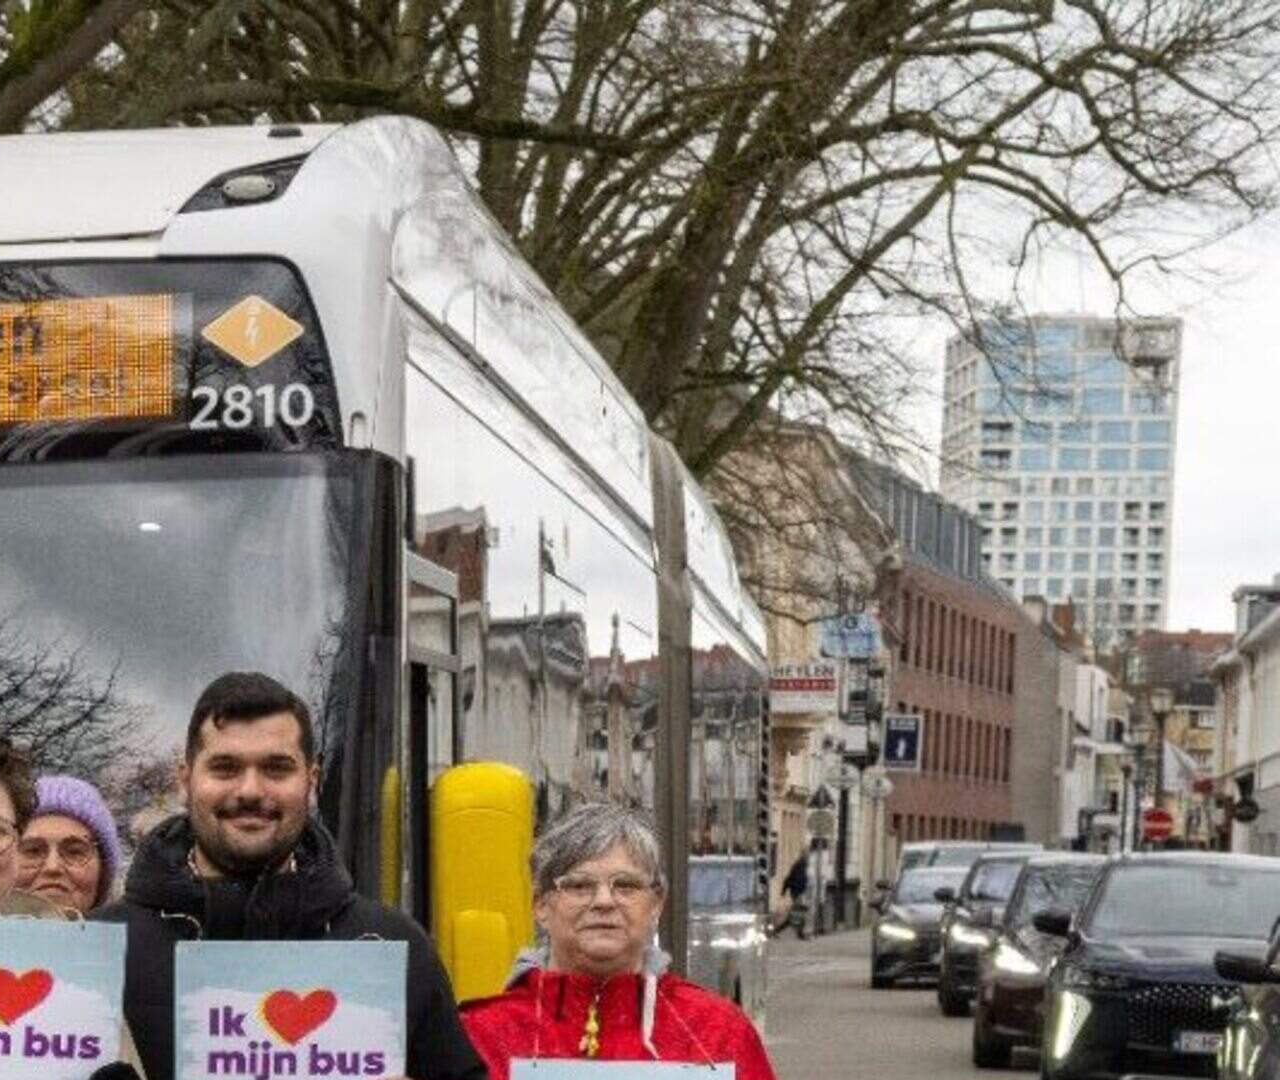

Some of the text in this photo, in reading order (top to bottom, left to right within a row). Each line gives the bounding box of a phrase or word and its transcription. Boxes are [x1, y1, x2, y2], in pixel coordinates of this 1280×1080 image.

[190, 383, 314, 430] 2810
[209, 1005, 247, 1037] Ik
[23, 1026, 101, 1060] bus
[308, 1043, 386, 1076] bus
